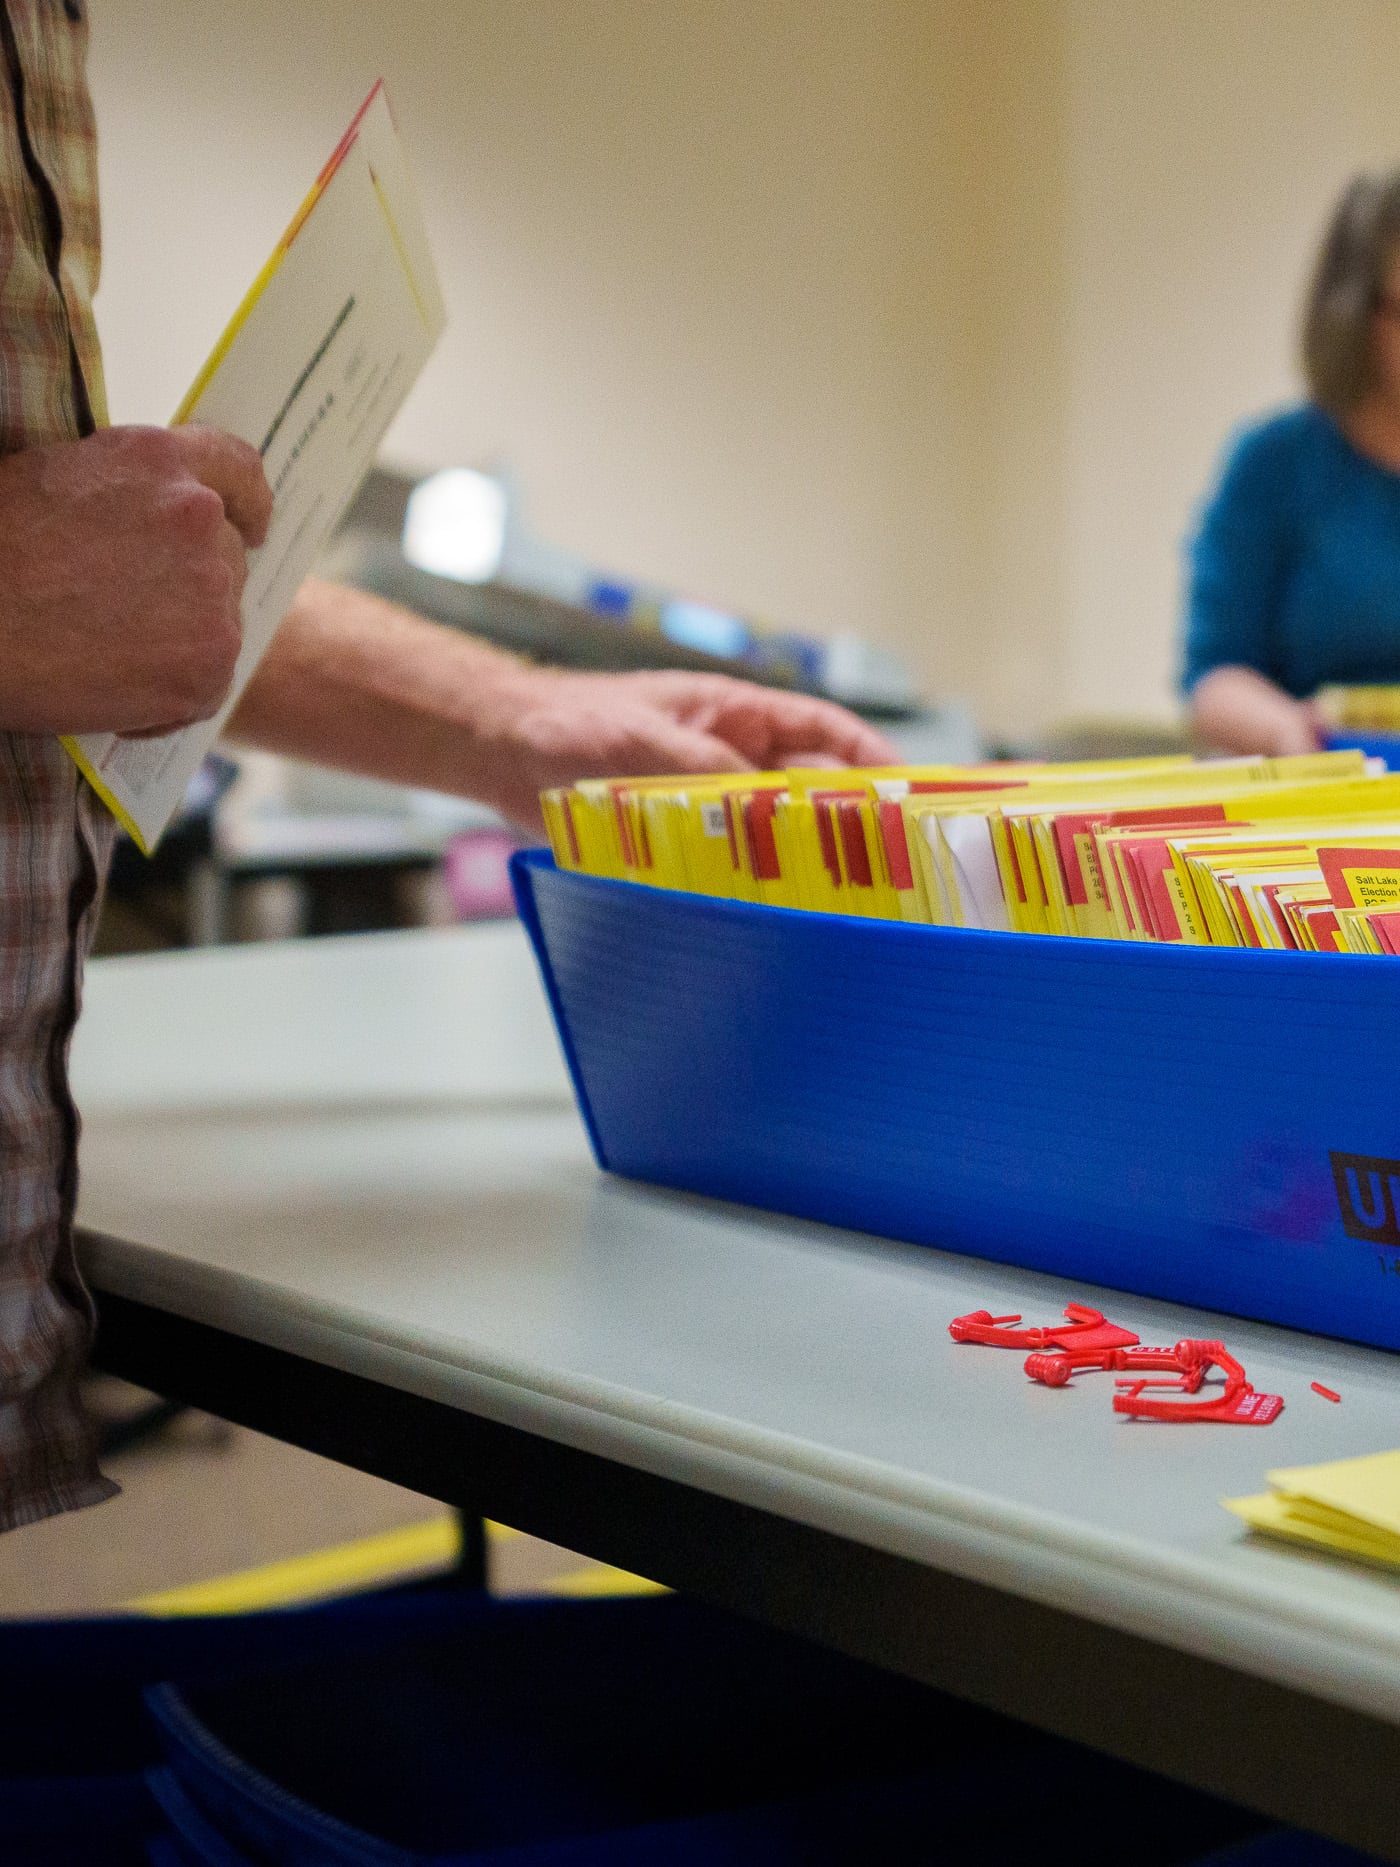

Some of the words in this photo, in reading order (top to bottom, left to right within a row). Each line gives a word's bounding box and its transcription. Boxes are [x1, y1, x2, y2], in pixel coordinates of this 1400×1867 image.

[1356, 875, 1375, 884] Salt
[1376, 876, 1398, 885] Lake
[1360, 887, 1397, 896] Election
